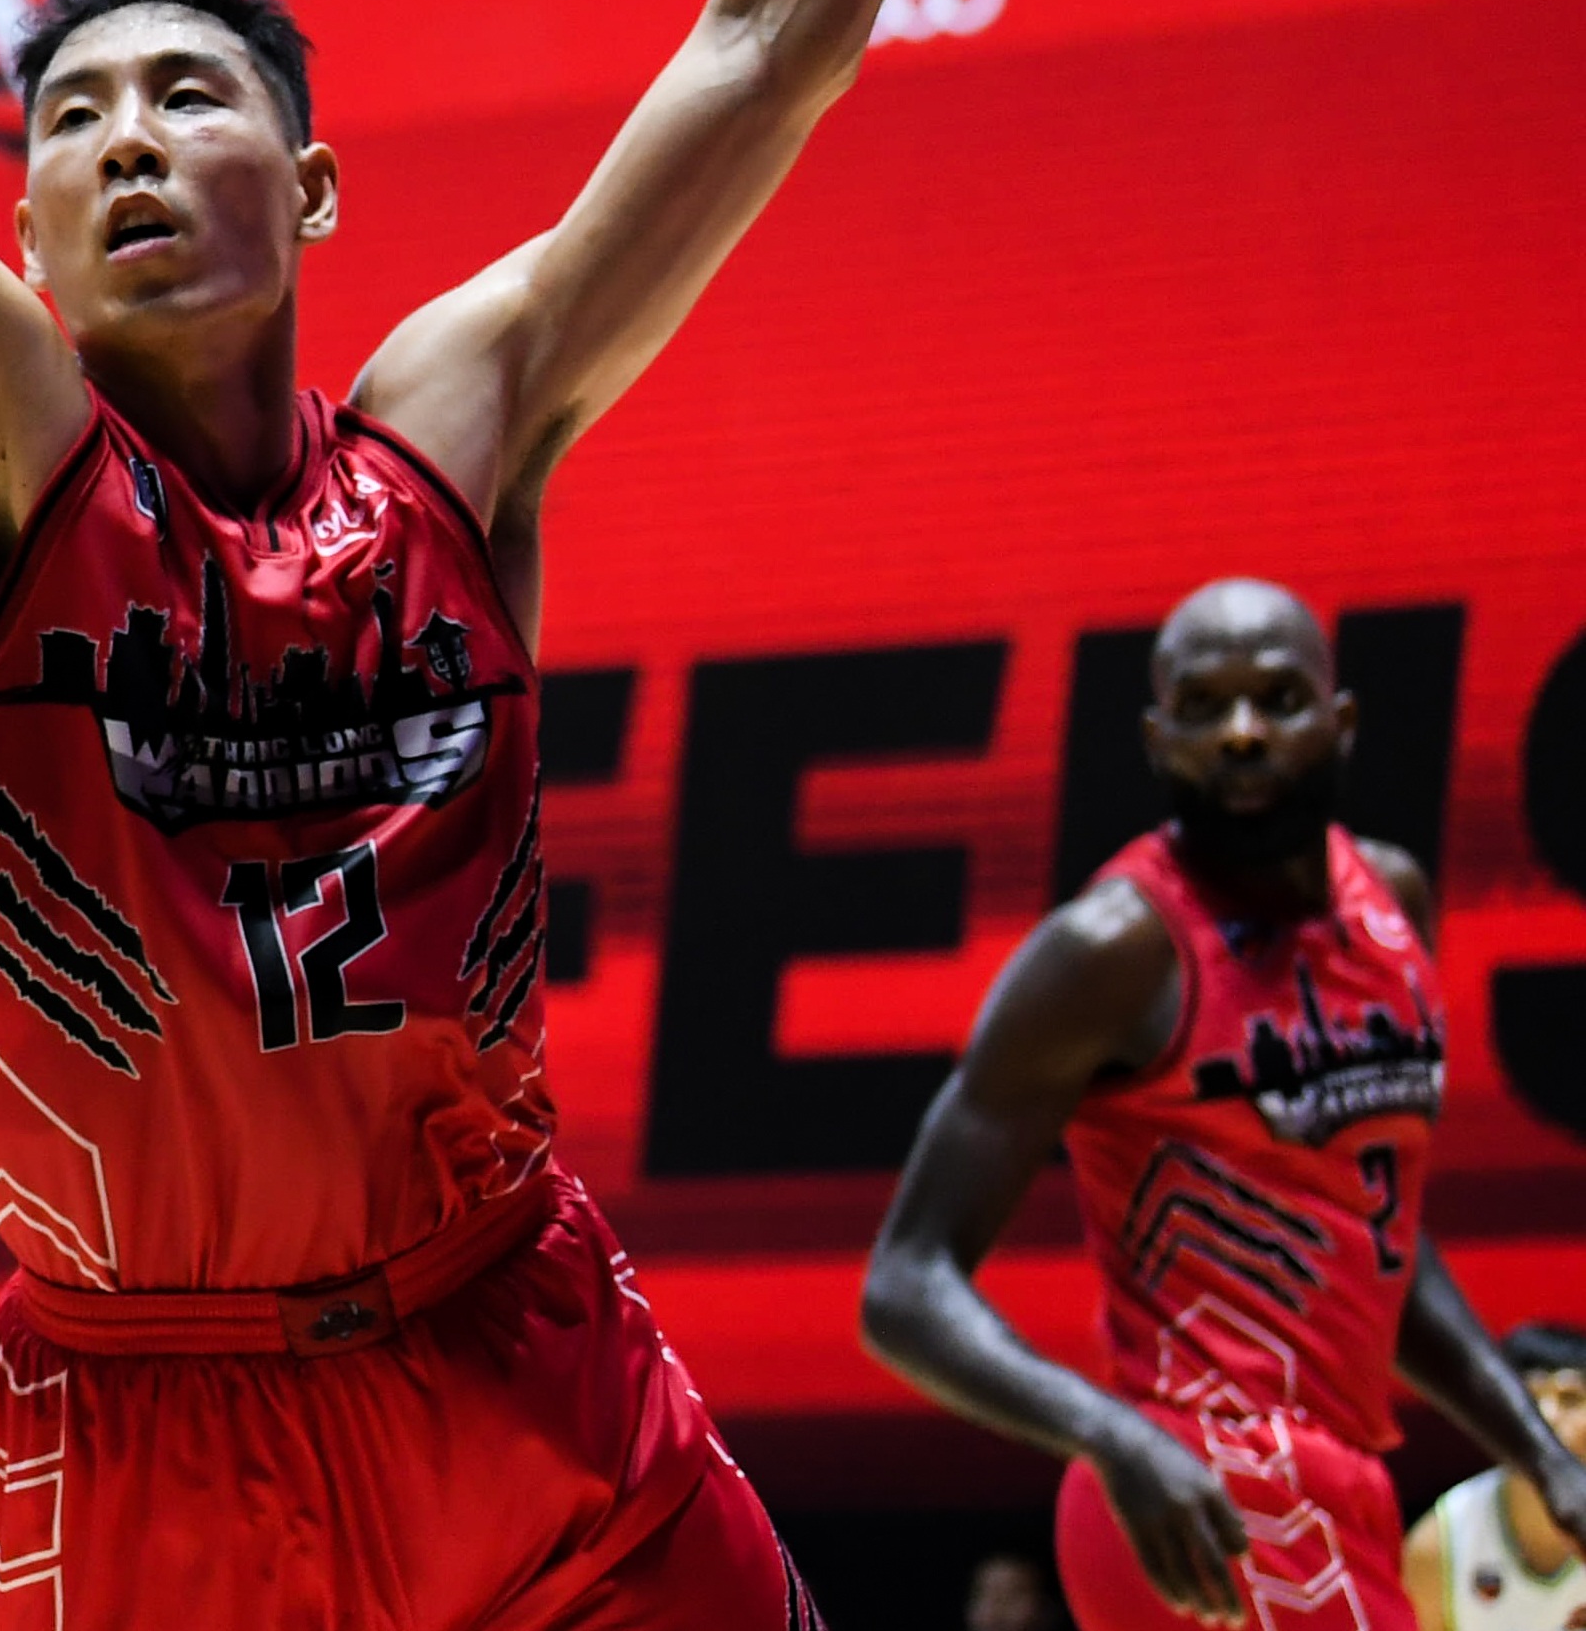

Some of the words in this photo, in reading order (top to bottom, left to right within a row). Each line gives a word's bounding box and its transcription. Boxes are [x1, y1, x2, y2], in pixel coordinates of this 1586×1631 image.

[103, 700, 489, 816] WARRIORS
[301, 722, 383, 758] LONG
[219, 838, 406, 1053] 12
[1354, 1141, 1403, 1275] 2
